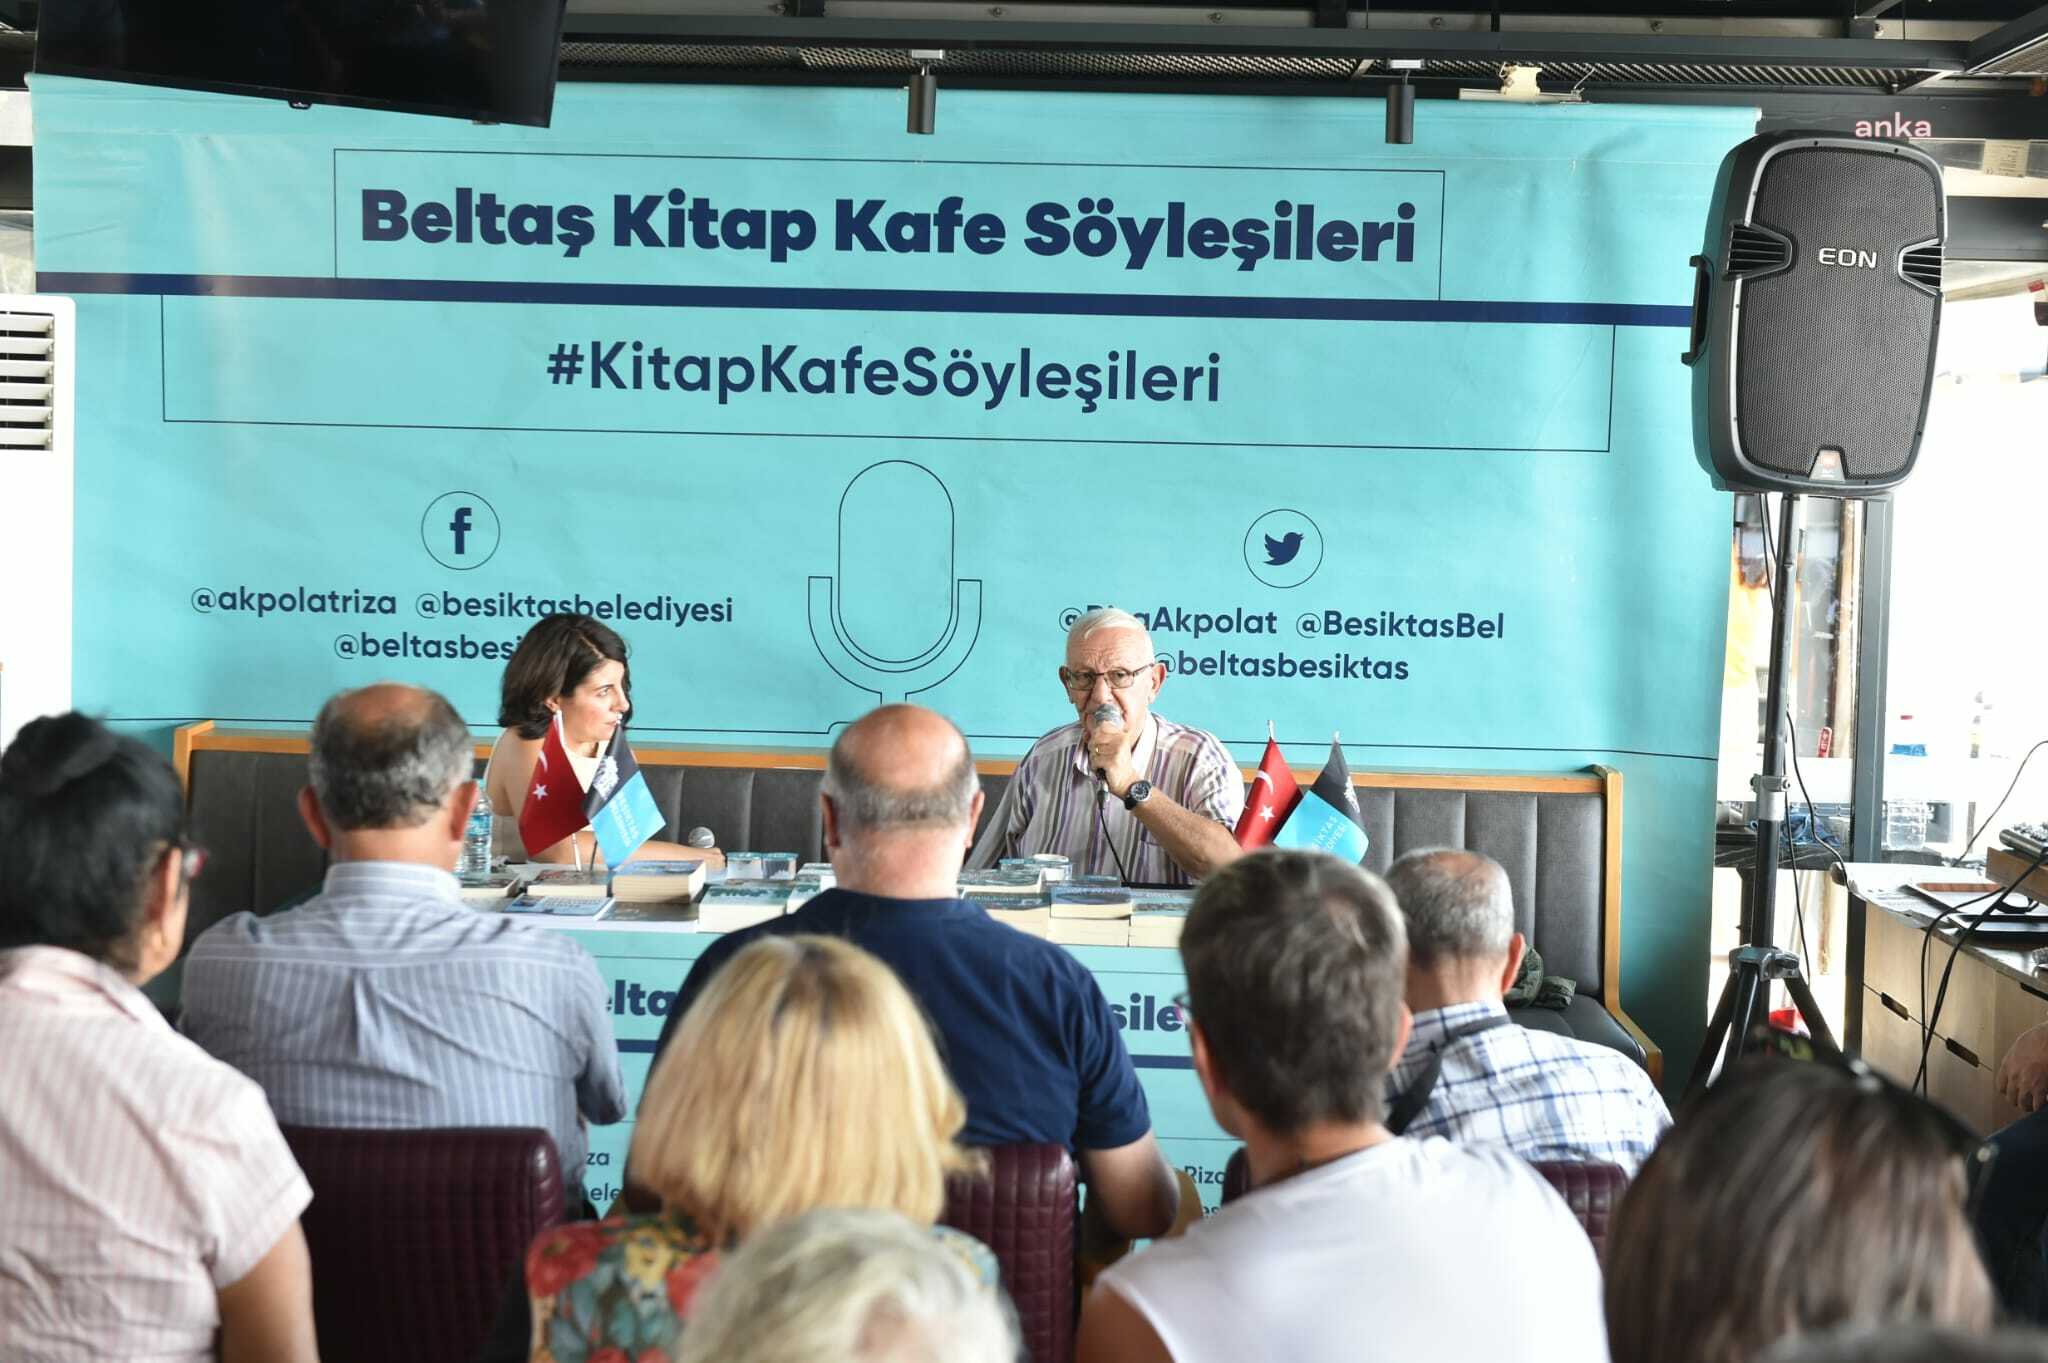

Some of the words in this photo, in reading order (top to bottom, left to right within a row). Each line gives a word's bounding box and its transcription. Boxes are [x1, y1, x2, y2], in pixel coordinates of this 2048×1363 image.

[361, 187, 595, 258] Beltaş
[613, 188, 816, 263] Kitap
[834, 196, 1007, 256] Kafe
[1023, 197, 1416, 272] Söyleşileri
[1819, 248, 1877, 269] EON
[546, 341, 1221, 414] #KitapKafeSöyleşileri
[191, 586, 397, 618] @akpolatriza
[416, 591, 733, 627] @besiktasbelediyesi
[1296, 610, 1504, 639] @BesiktasBel
